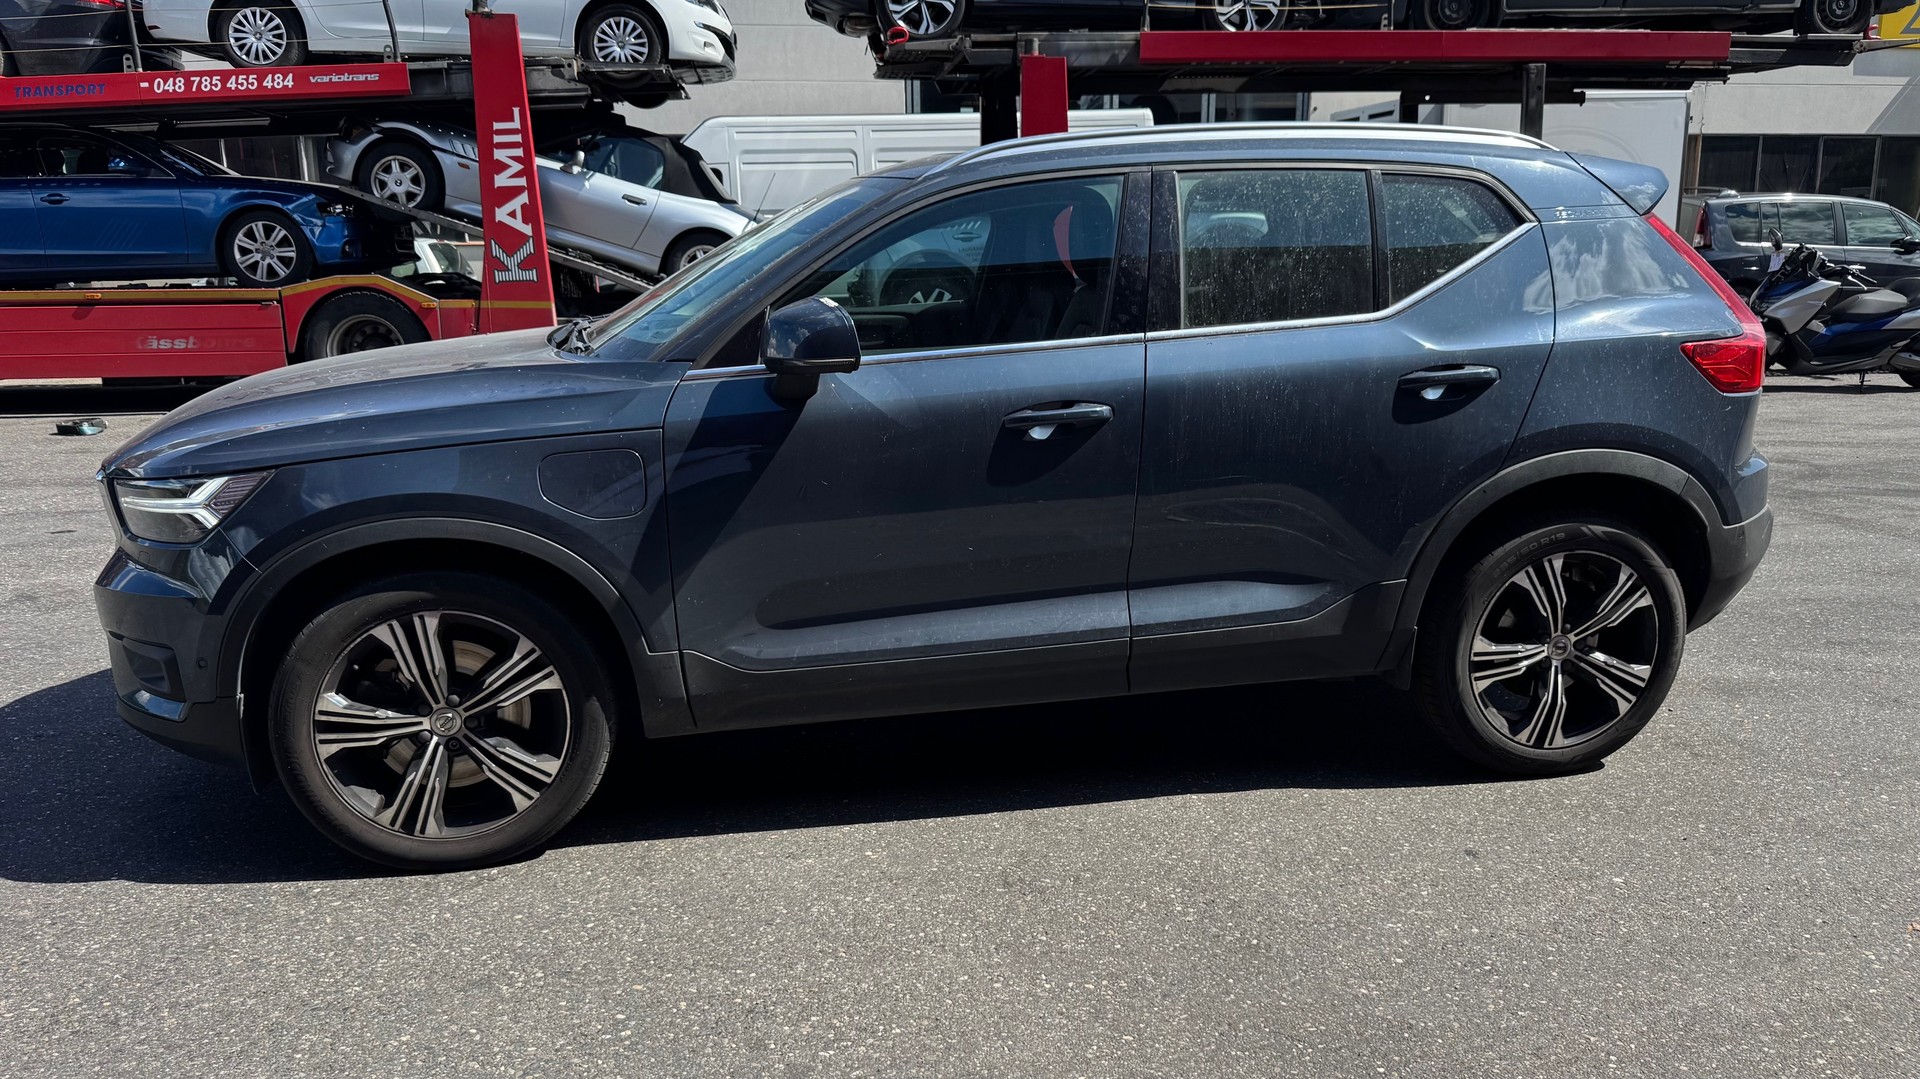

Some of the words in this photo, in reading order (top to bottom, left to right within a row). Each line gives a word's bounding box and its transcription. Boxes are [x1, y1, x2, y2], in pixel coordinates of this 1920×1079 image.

[13, 83, 106, 98] TRANSPORT
[153, 77, 185, 94] 048
[190, 75, 222, 93] 785
[226, 74, 258, 91] 455
[262, 73, 294, 90] 484
[309, 72, 380, 83] variotrans
[490, 107, 538, 284] KAMIL
